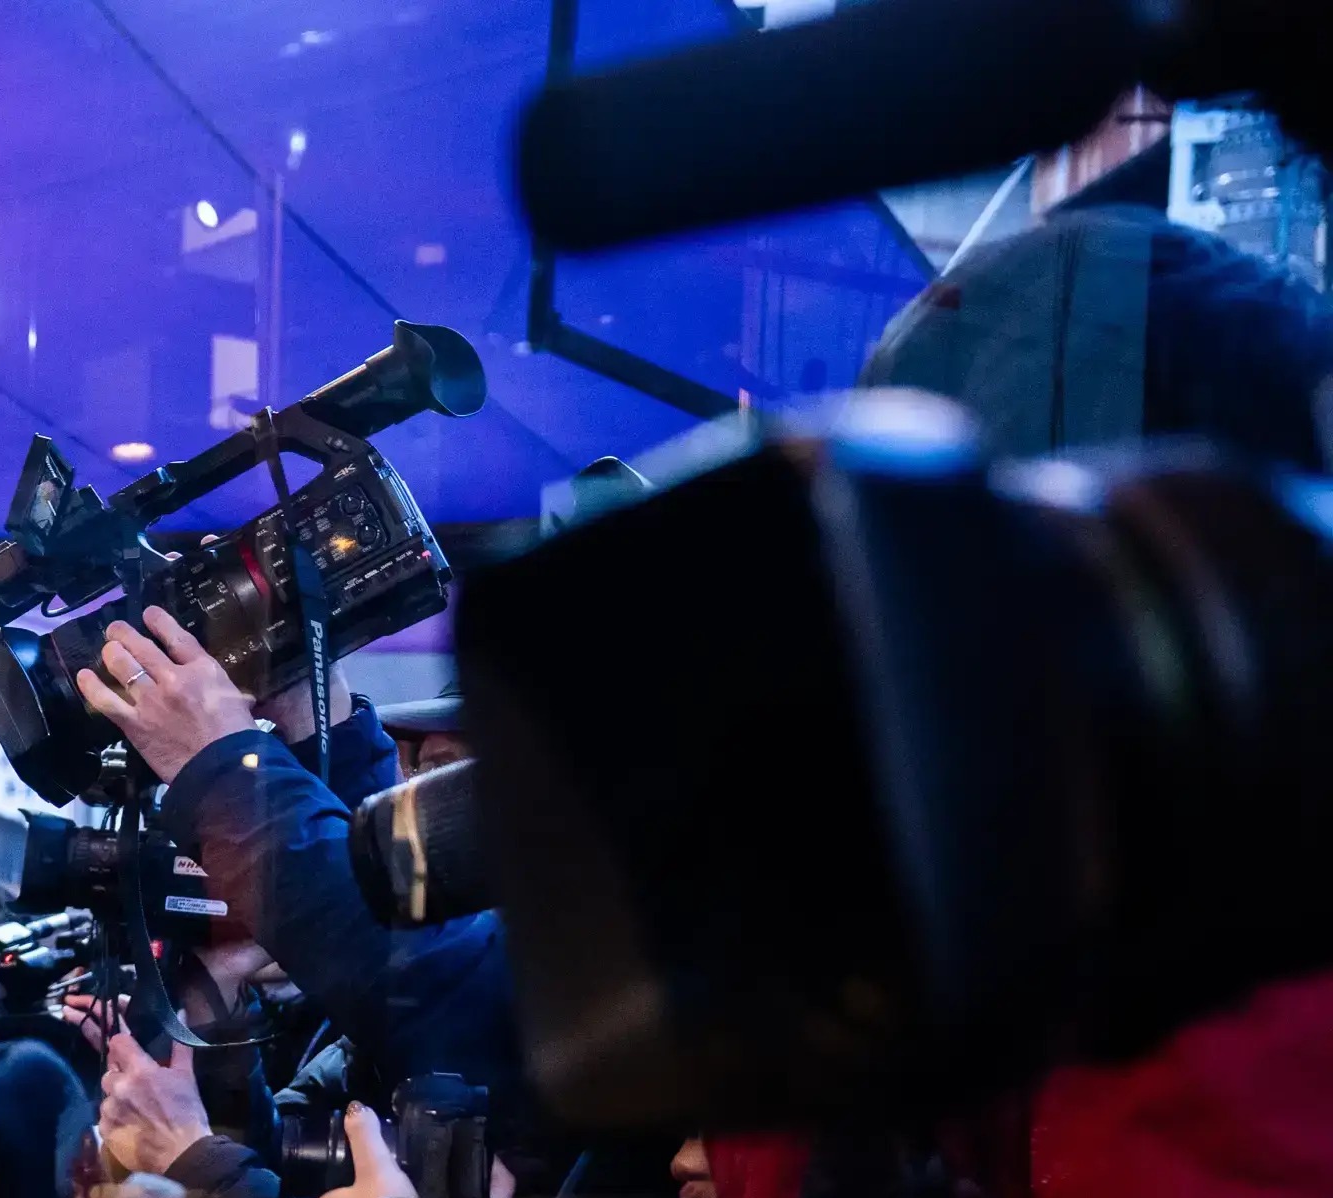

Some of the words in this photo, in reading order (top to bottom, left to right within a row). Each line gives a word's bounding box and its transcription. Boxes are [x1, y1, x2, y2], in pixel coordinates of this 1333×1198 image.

[333, 462, 358, 480] 4K
[310, 619, 328, 755] Panasonic
[177, 859, 201, 870] NH
